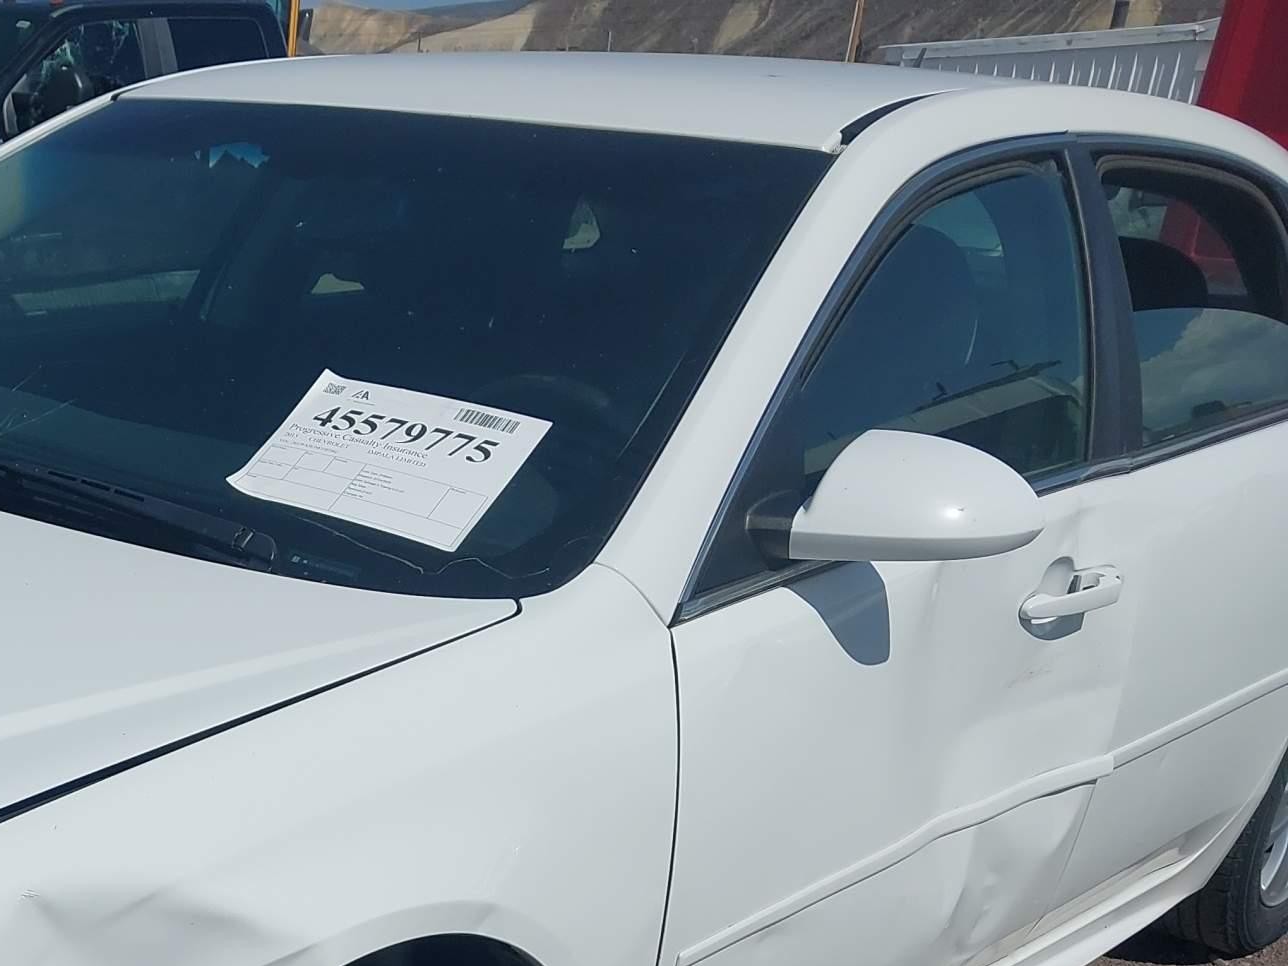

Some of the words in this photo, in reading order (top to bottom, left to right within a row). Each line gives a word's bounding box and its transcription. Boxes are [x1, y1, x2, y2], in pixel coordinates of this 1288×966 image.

[289, 423, 341, 439] Progressive
[342, 434, 380, 449] Casualty
[383, 442, 428, 459] Insurance
[309, 437, 350, 449] CHEVROLET
[368, 449, 394, 461] IMPALA
[395, 456, 427, 468] LIMITED
[313, 406, 500, 463] 45579775
